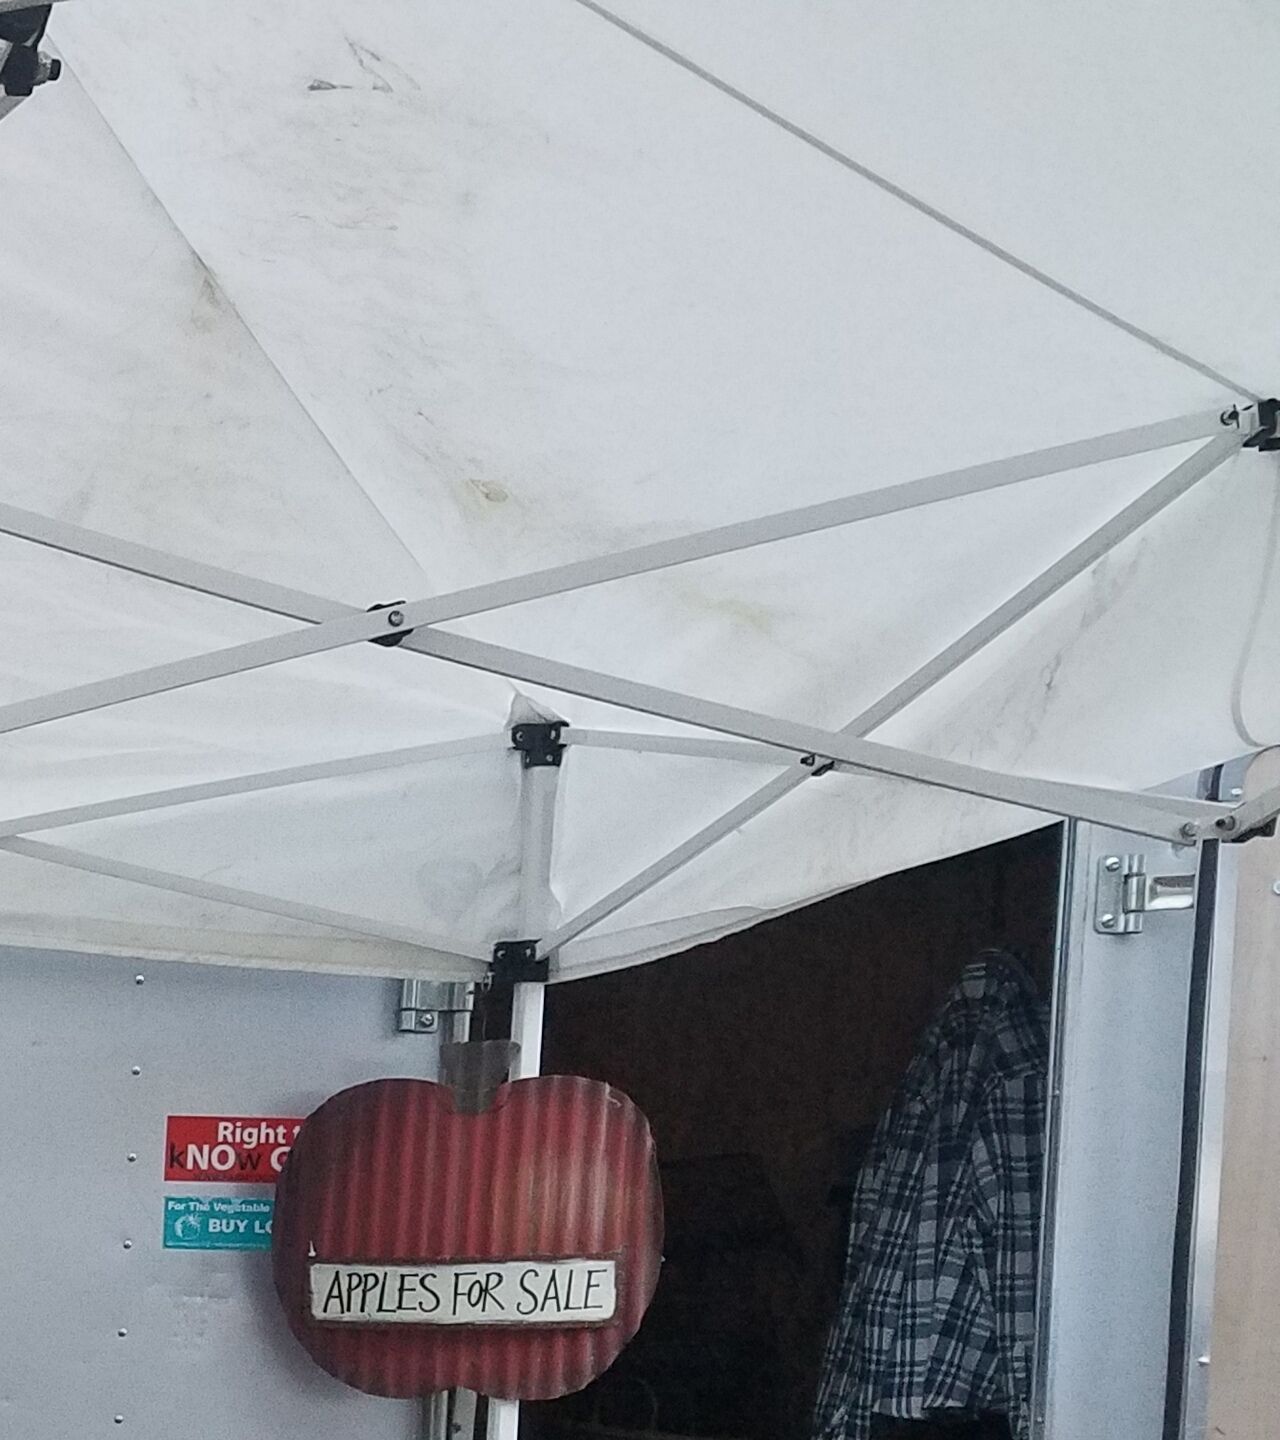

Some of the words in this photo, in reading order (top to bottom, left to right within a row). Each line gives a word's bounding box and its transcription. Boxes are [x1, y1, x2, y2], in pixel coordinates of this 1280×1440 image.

[218, 1122, 286, 1149] Right
[168, 1201, 185, 1210] For
[208, 1219, 248, 1233] BUY
[323, 1271, 440, 1314] APPLES
[452, 1271, 505, 1315] FOR
[516, 1268, 608, 1315] SALE
